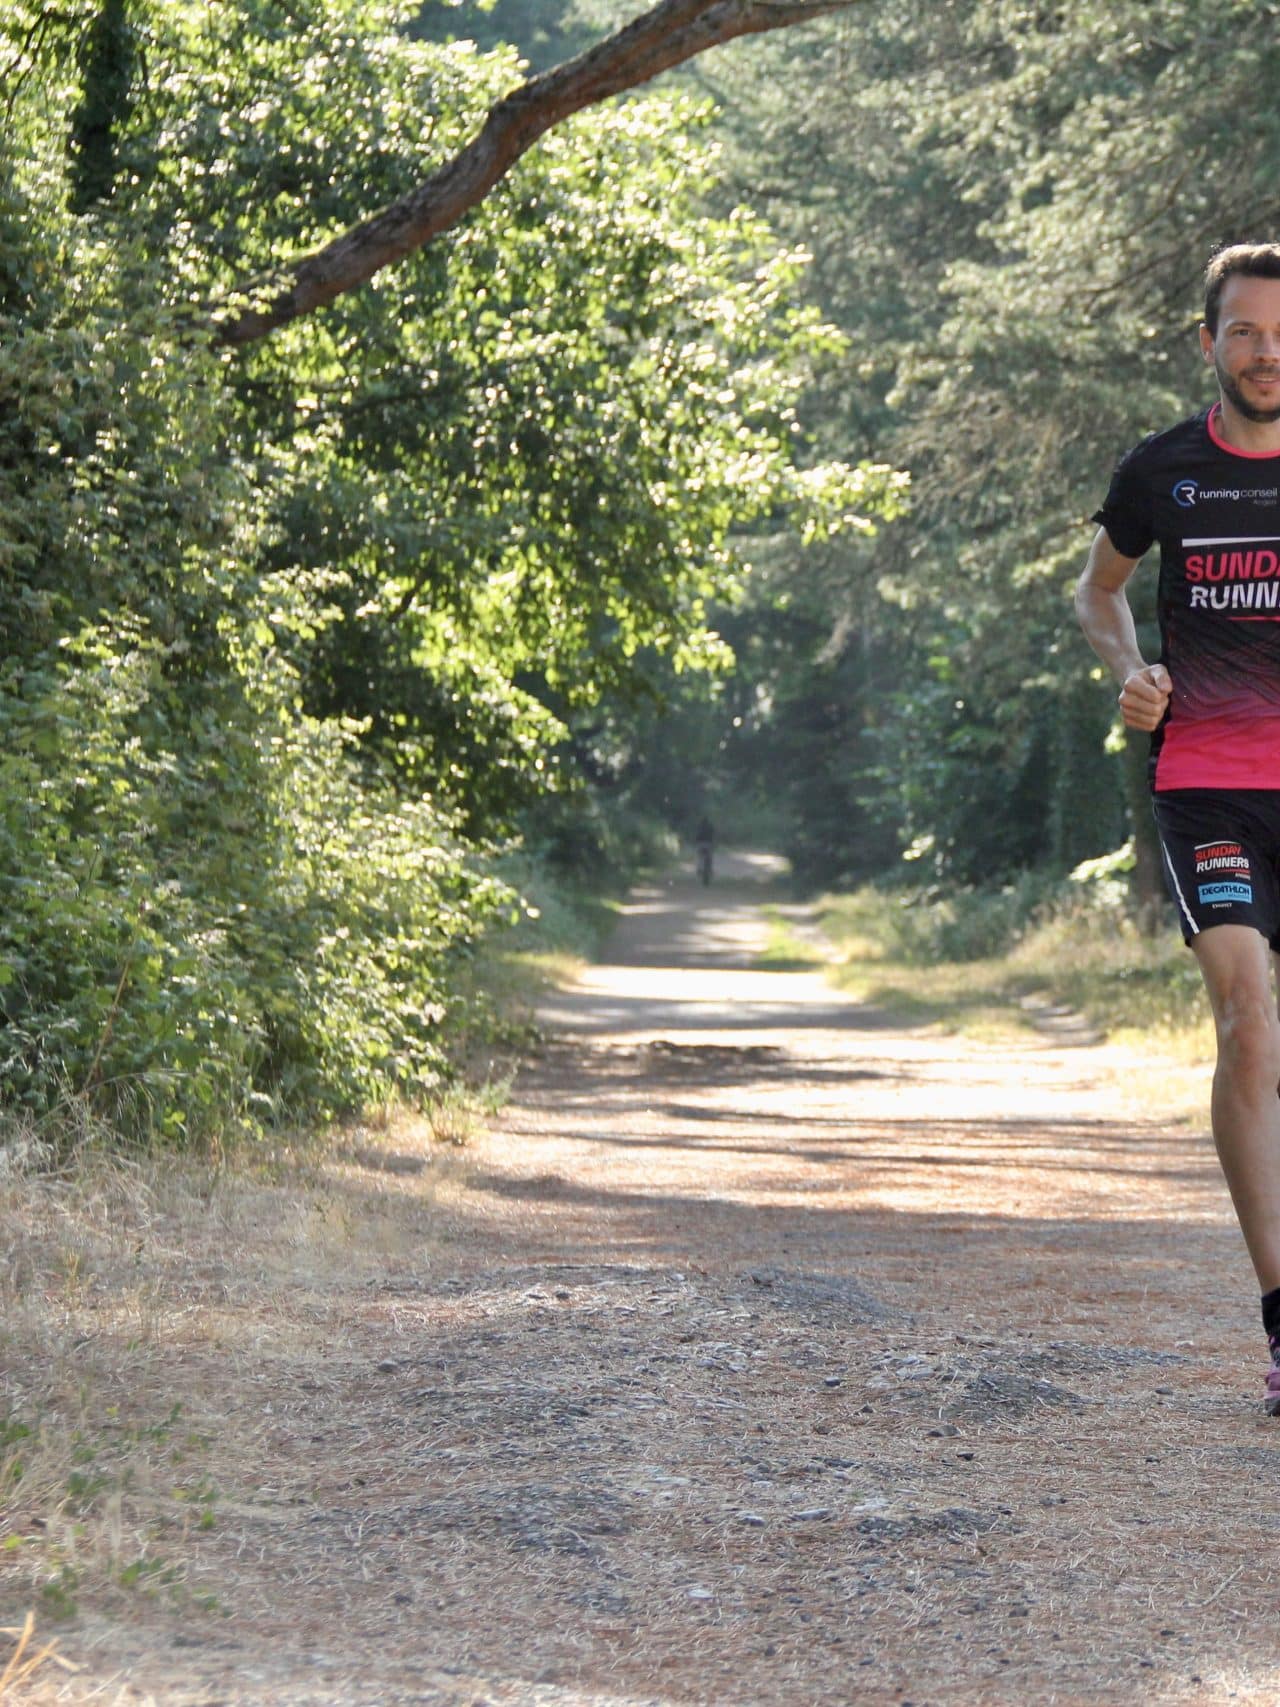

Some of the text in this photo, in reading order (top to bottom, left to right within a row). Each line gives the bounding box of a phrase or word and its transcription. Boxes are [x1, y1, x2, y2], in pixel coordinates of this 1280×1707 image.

[1195, 845, 1241, 861] SUNDAY
[1196, 856, 1250, 873] RUNNERS
[1201, 885, 1250, 895] DECATHLON
